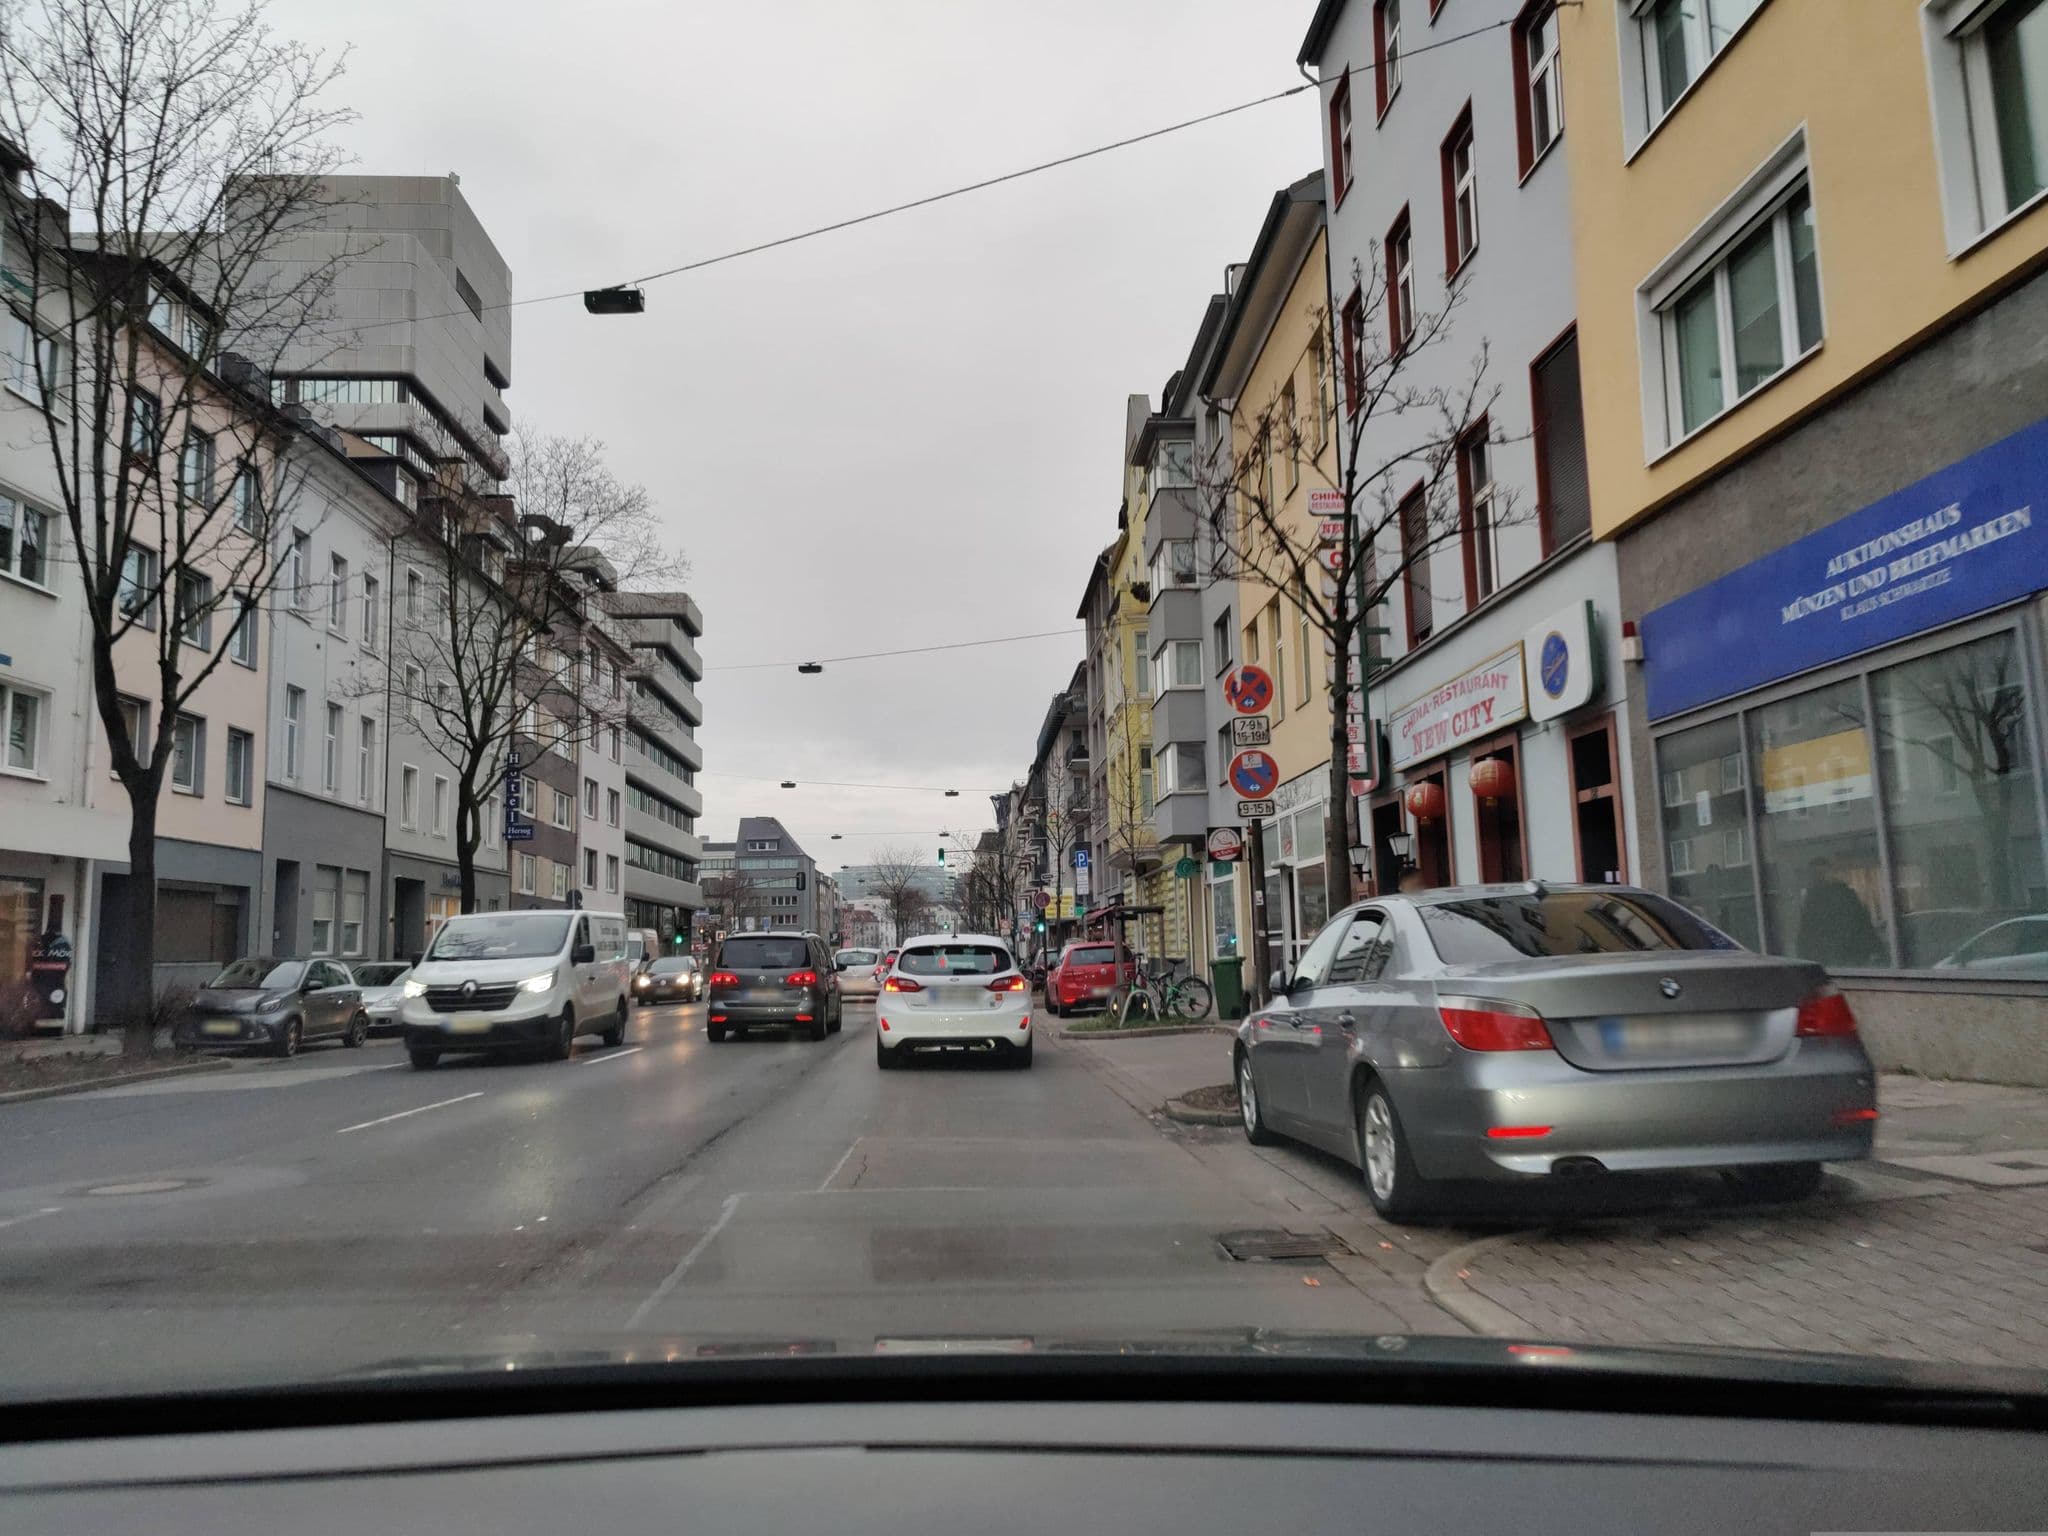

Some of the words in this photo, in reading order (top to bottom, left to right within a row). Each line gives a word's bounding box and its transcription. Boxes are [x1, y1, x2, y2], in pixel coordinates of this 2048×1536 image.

[1825, 502, 1962, 579] AUKTIONSHAUS
[1848, 567, 1888, 597] UND
[1888, 505, 2033, 582] BRIEFMARKEN
[1412, 718, 1449, 756] NEW
[1451, 696, 1496, 737] CITY
